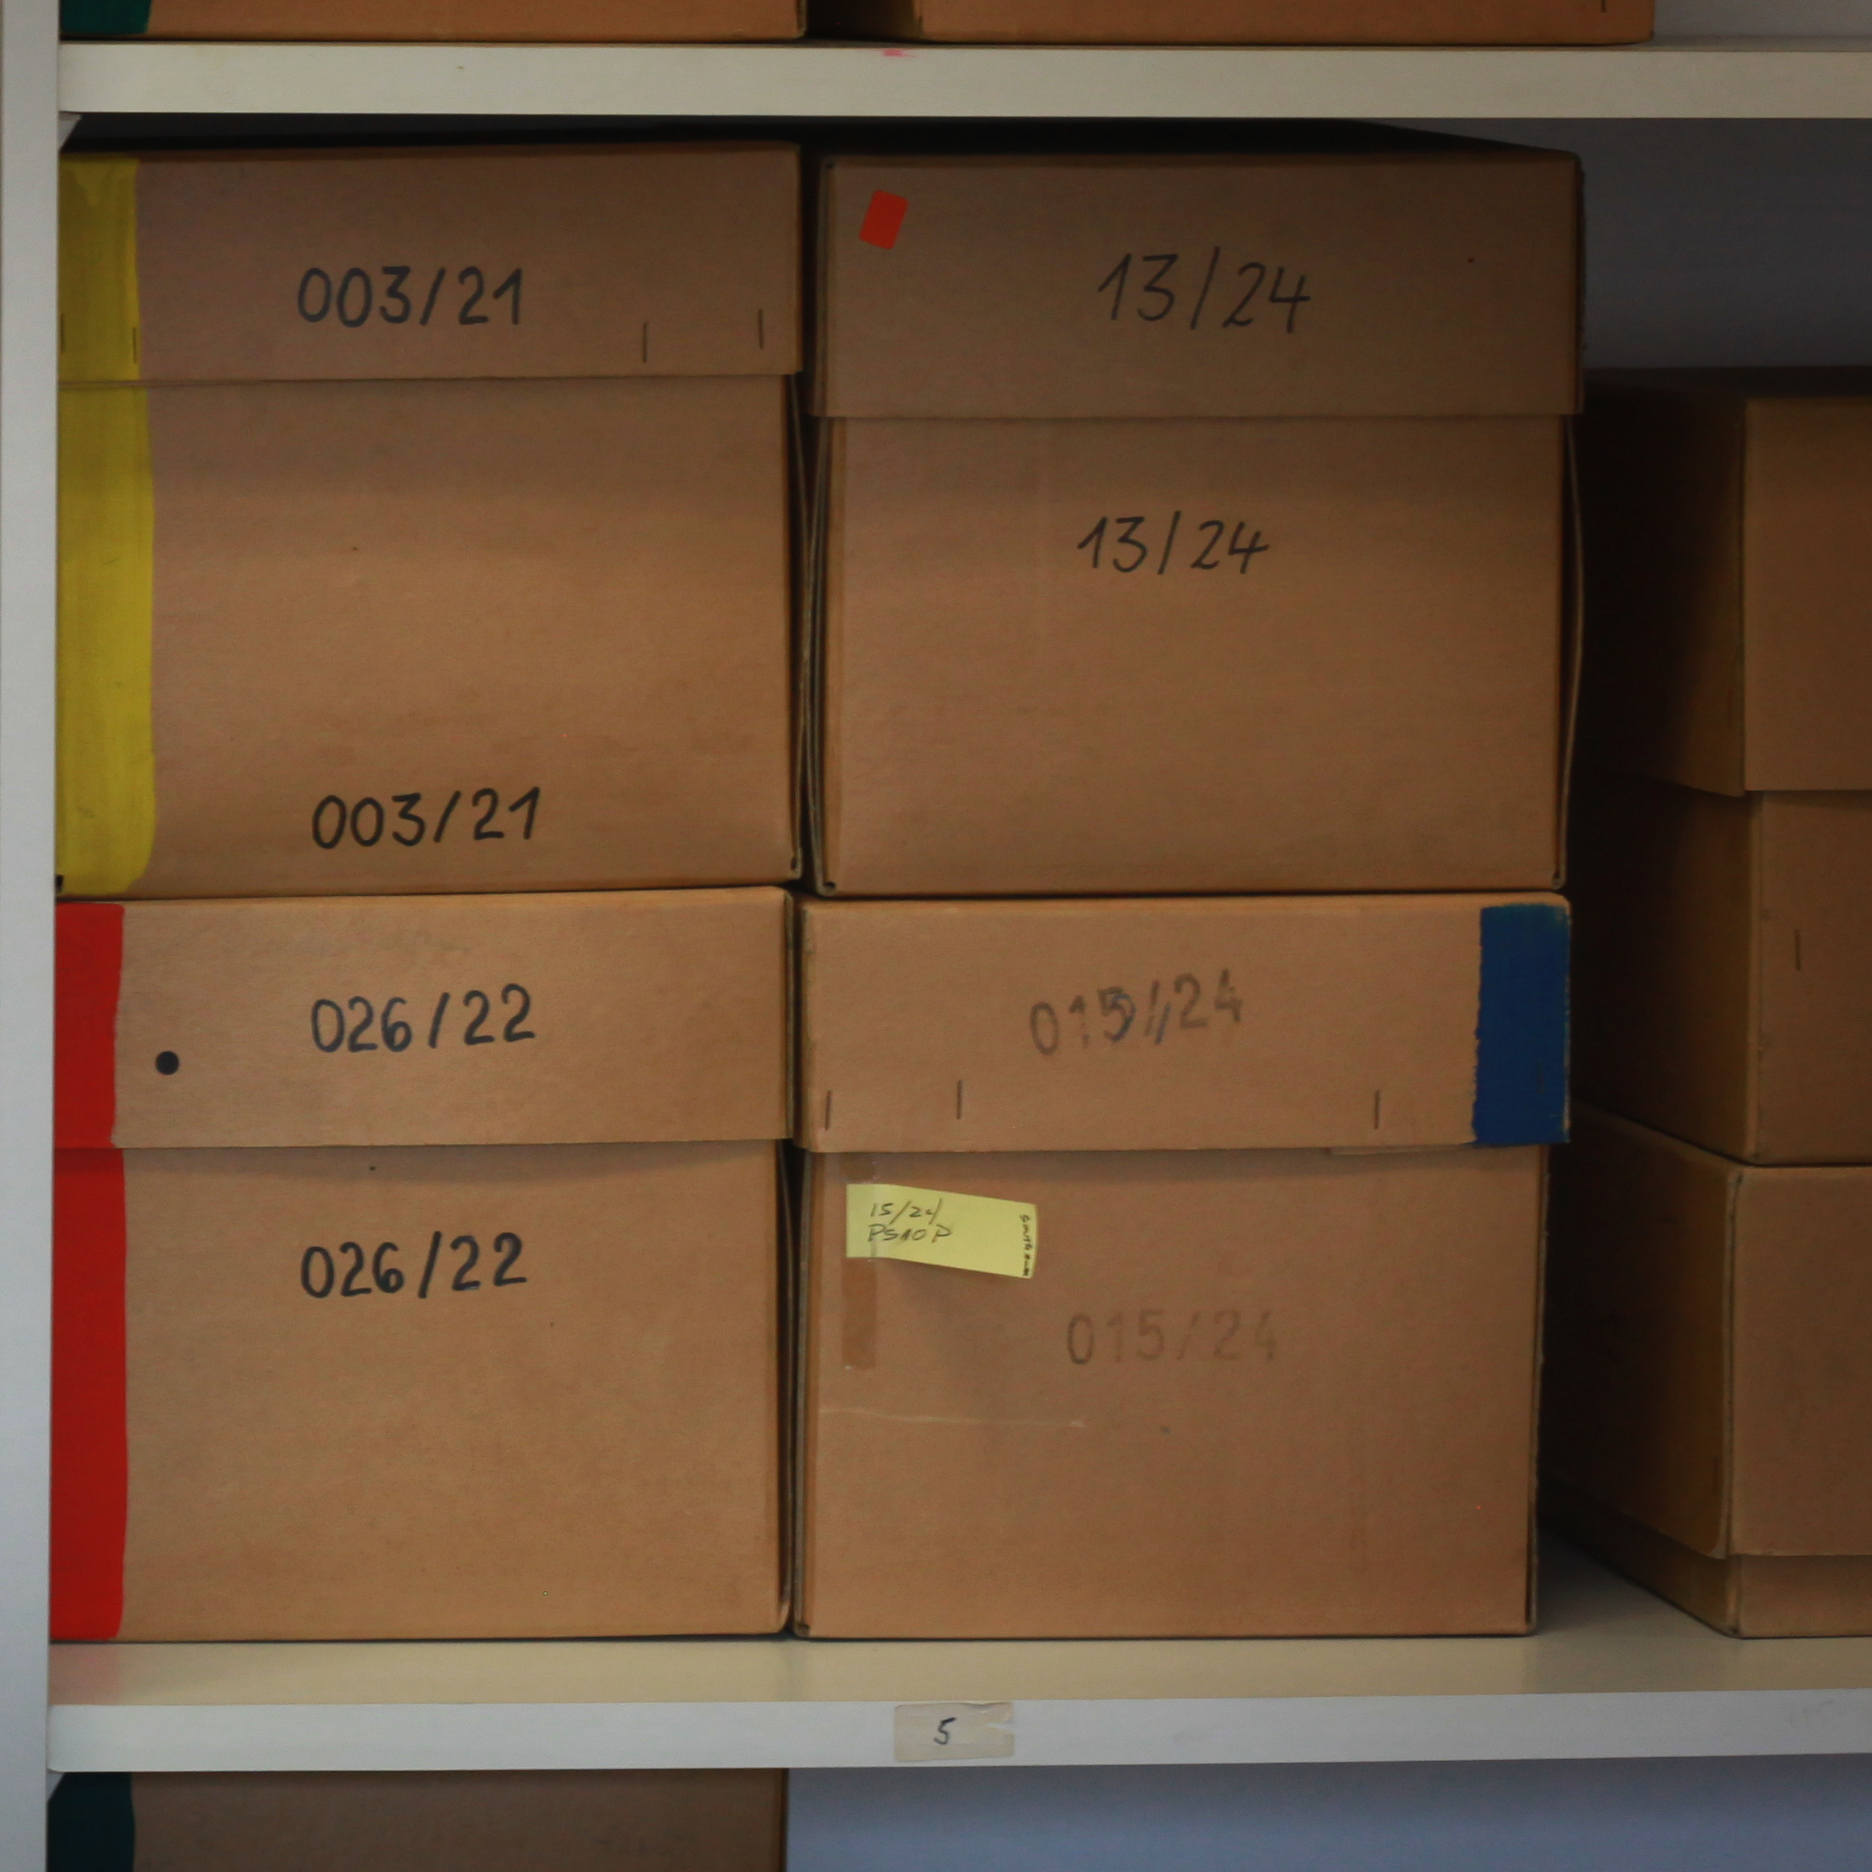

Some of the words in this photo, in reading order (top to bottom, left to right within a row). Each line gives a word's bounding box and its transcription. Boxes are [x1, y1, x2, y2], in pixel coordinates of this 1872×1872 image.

[296, 265, 523, 328] 003/21
[1097, 246, 1311, 334] 13/24
[1076, 510, 1270, 576] 13/24
[311, 786, 542, 850] 003/21
[310, 983, 537, 1054] 026/22
[299, 1230, 528, 1300] 026/22
[1066, 1308, 1277, 1365] 015/24
[933, 1716, 957, 1746] 5
